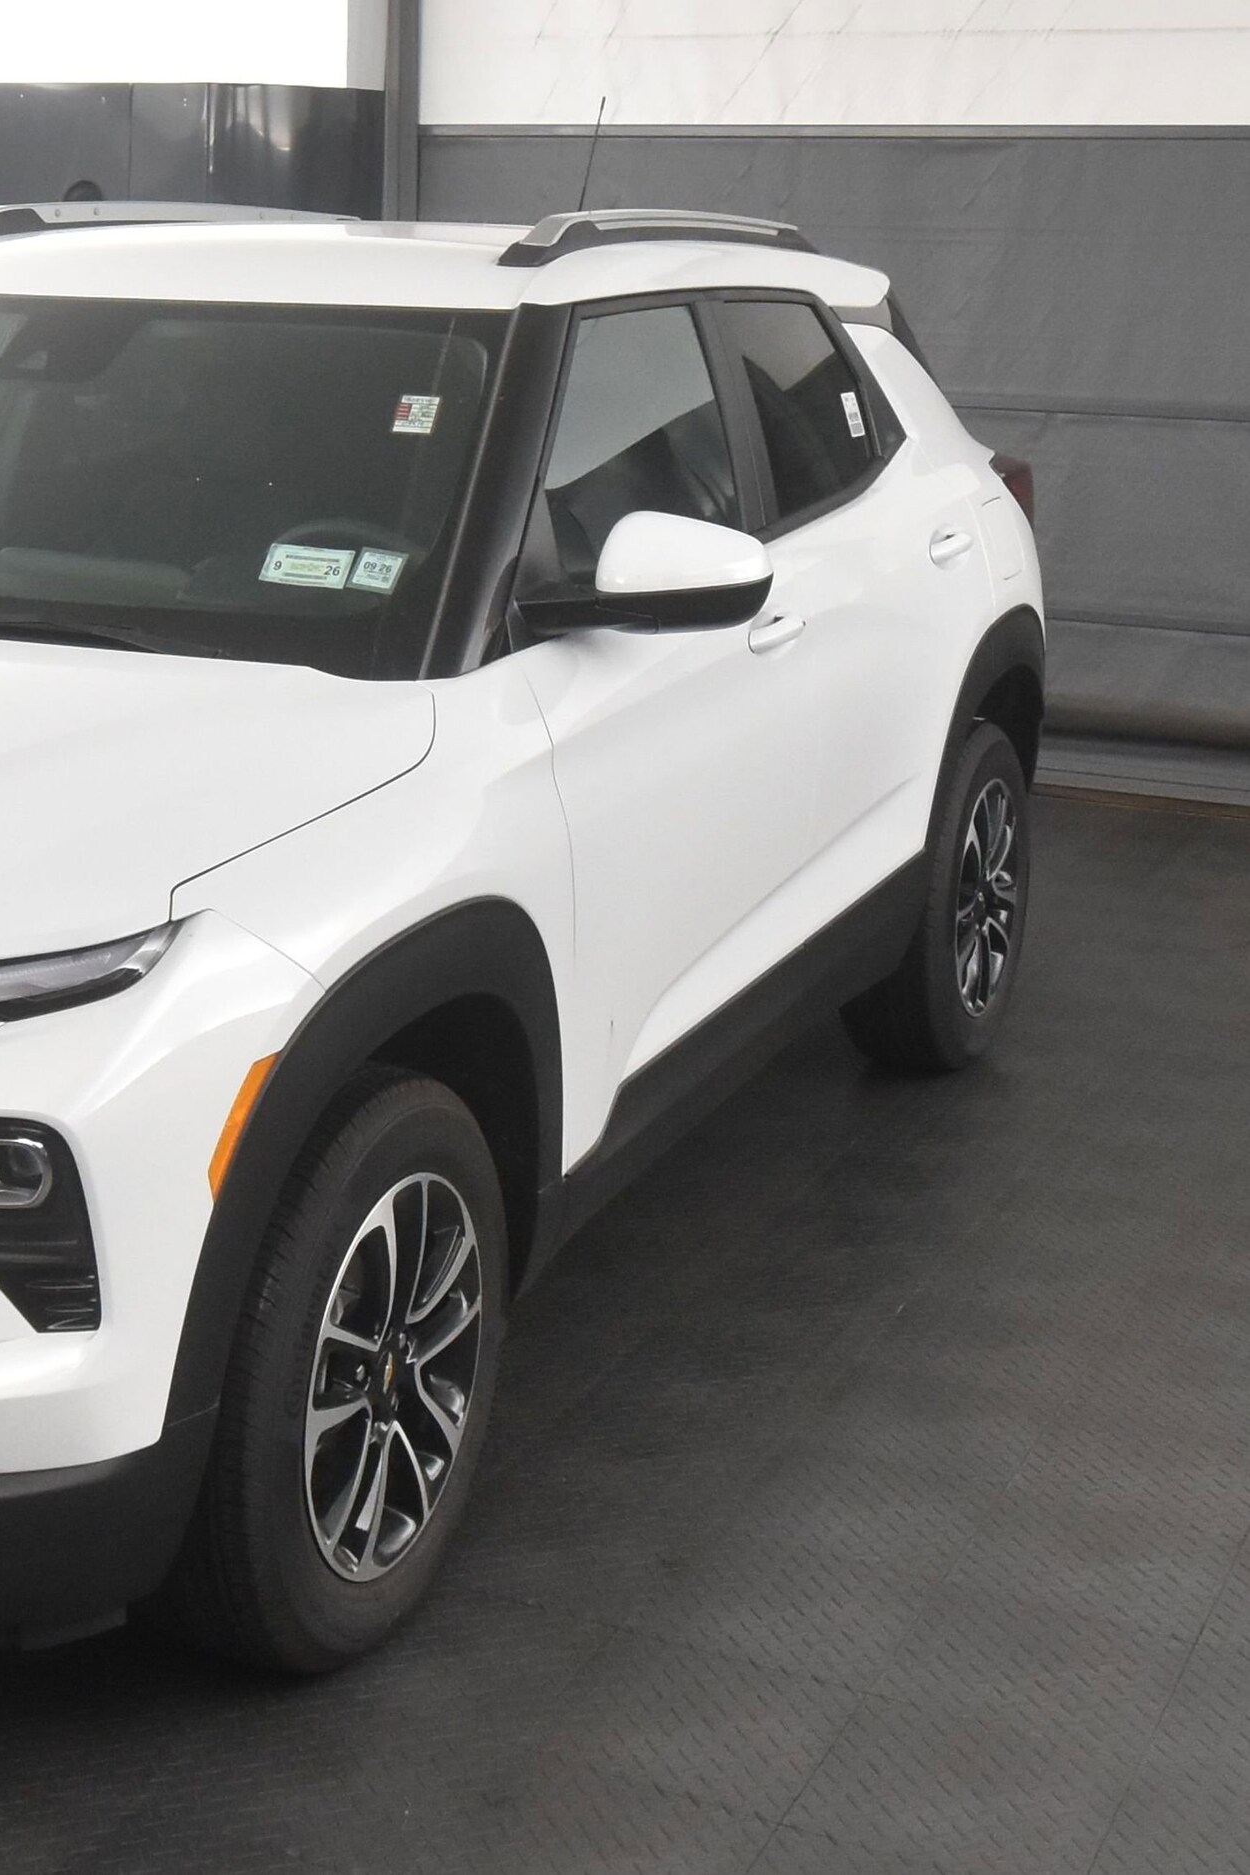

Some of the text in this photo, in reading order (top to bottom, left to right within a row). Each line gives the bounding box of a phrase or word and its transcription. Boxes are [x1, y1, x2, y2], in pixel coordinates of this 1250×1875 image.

[273, 560, 283, 571] 9
[323, 565, 341, 577] 26
[363, 561, 392, 573] 09 26
